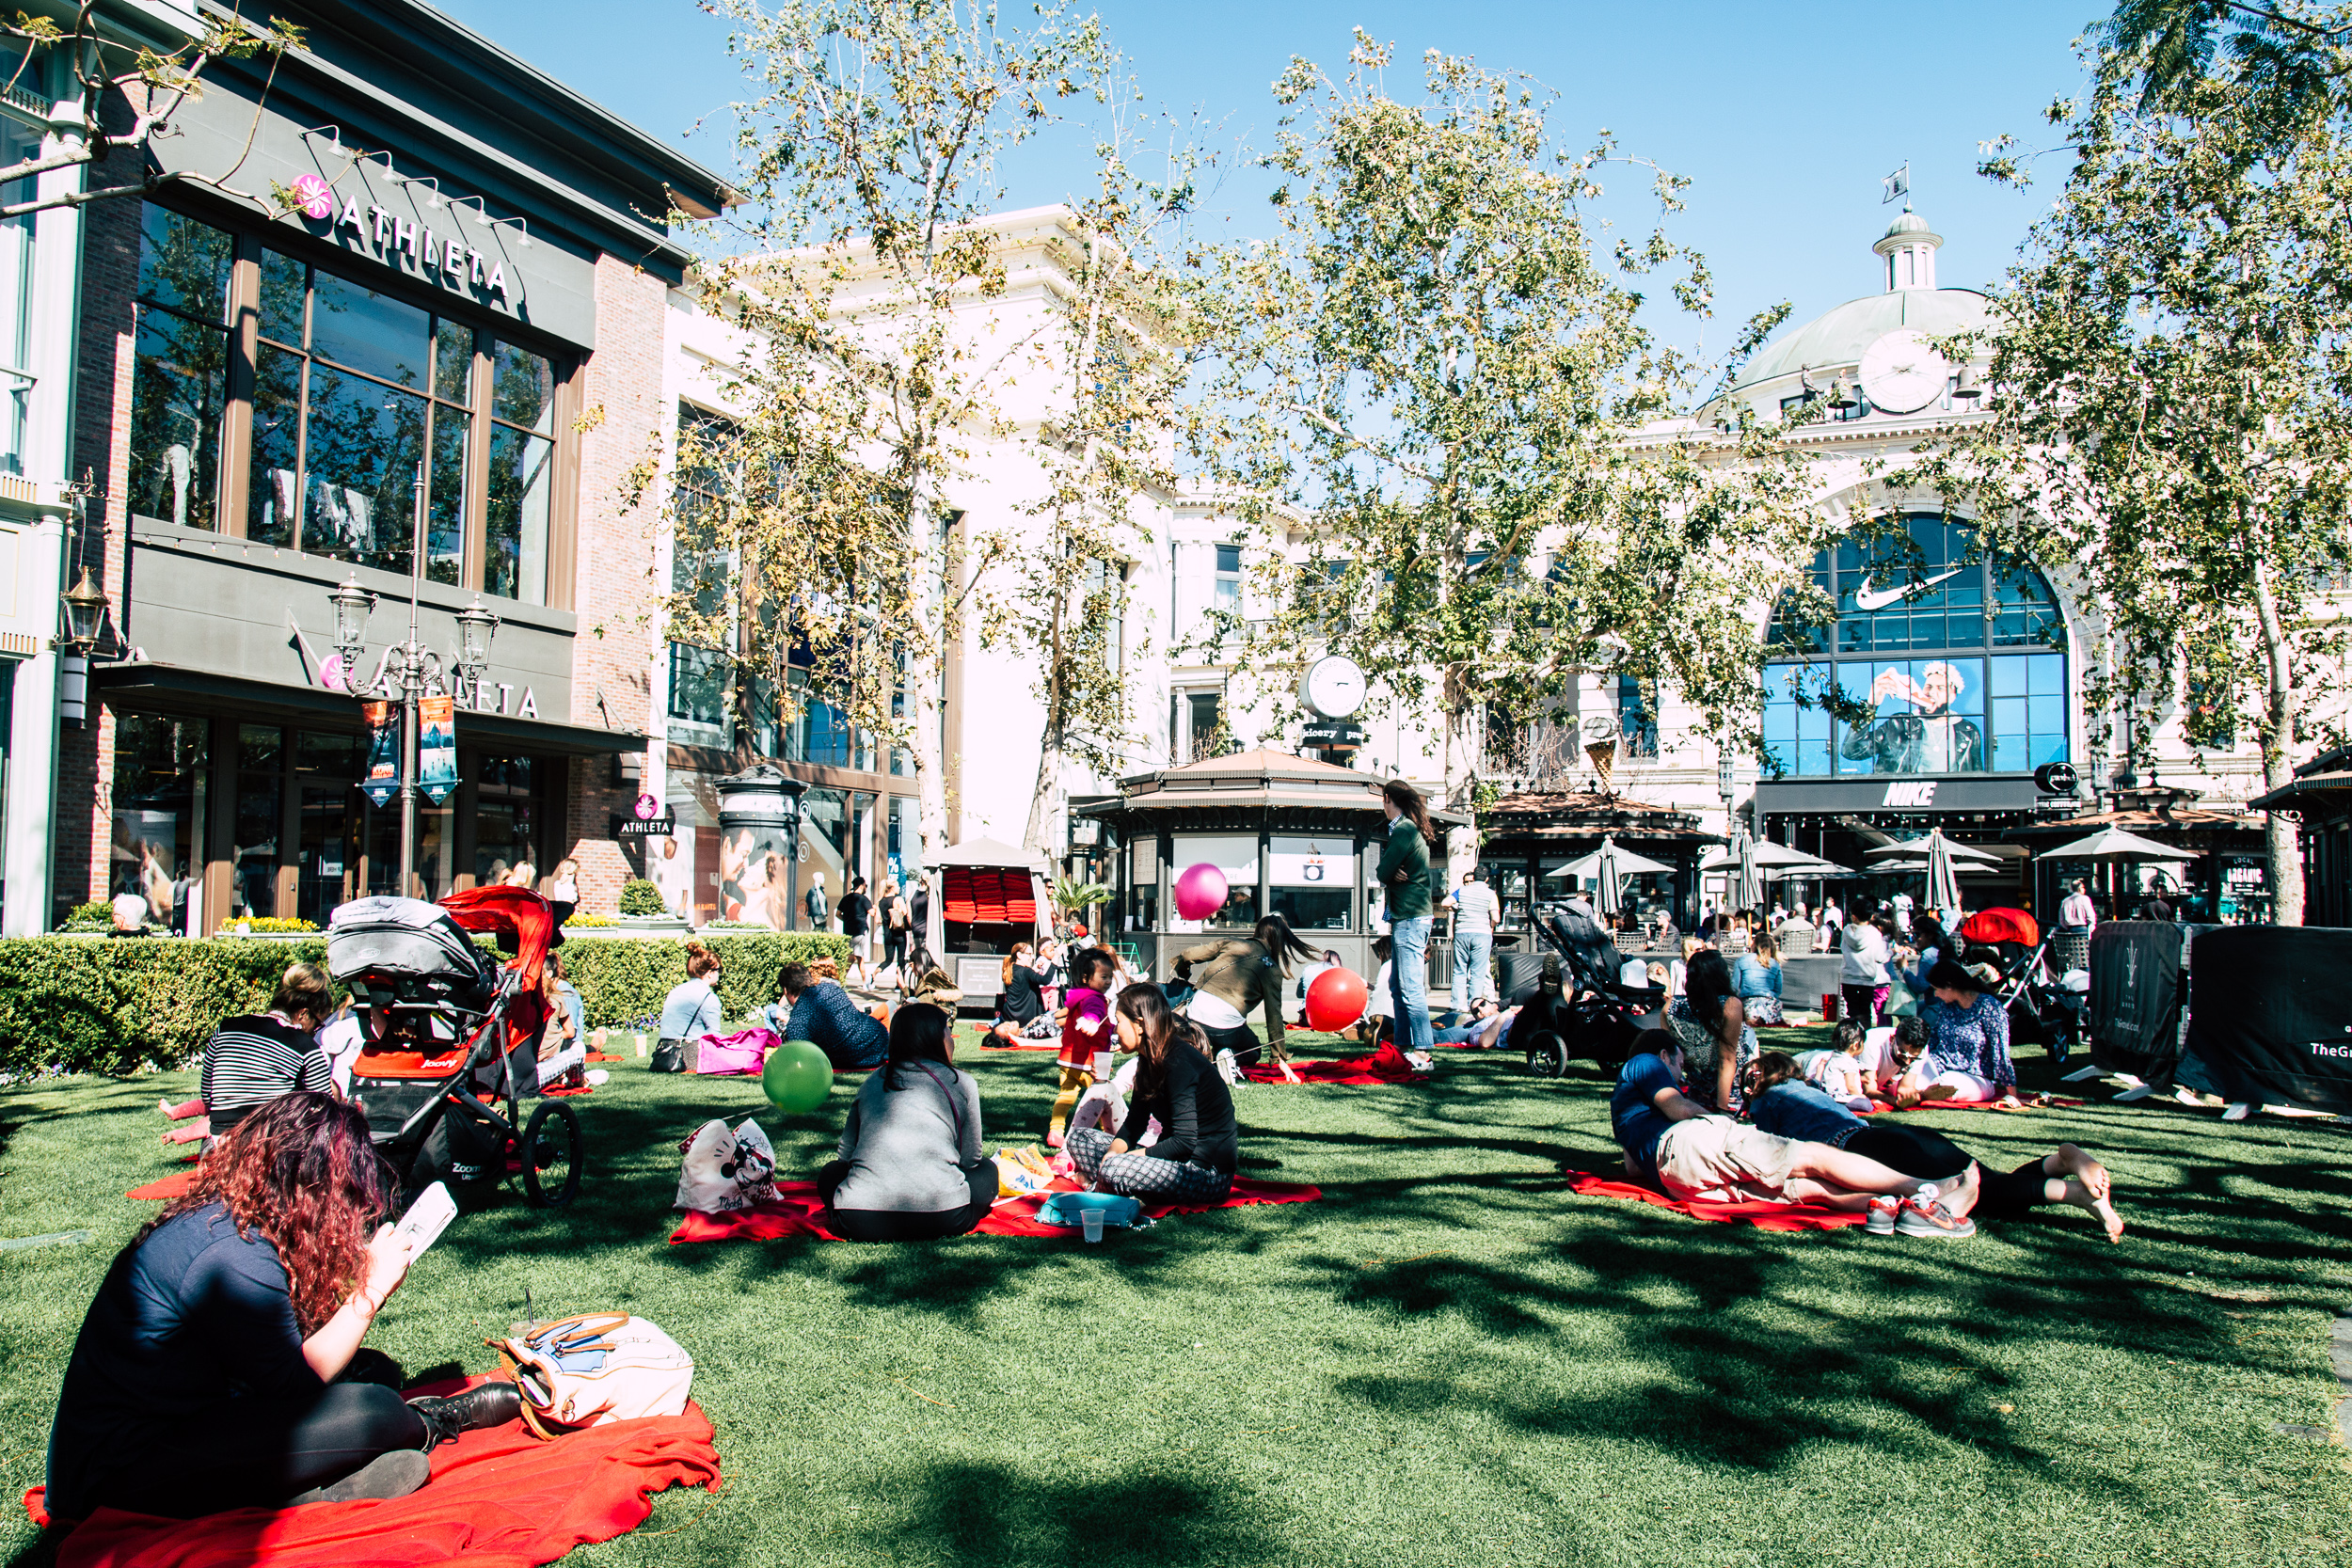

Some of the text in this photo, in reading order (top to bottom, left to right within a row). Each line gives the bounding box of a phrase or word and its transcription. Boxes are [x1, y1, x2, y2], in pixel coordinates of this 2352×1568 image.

[339, 195, 509, 297] ATHLETA
[1313, 660, 1338, 682] PRESSED
[1883, 782, 1937, 807] NIKE
[621, 822, 670, 832] ATHLETA
[2227, 868, 2263, 883] ORGANIC
[453, 1163, 481, 1173] Zoom
